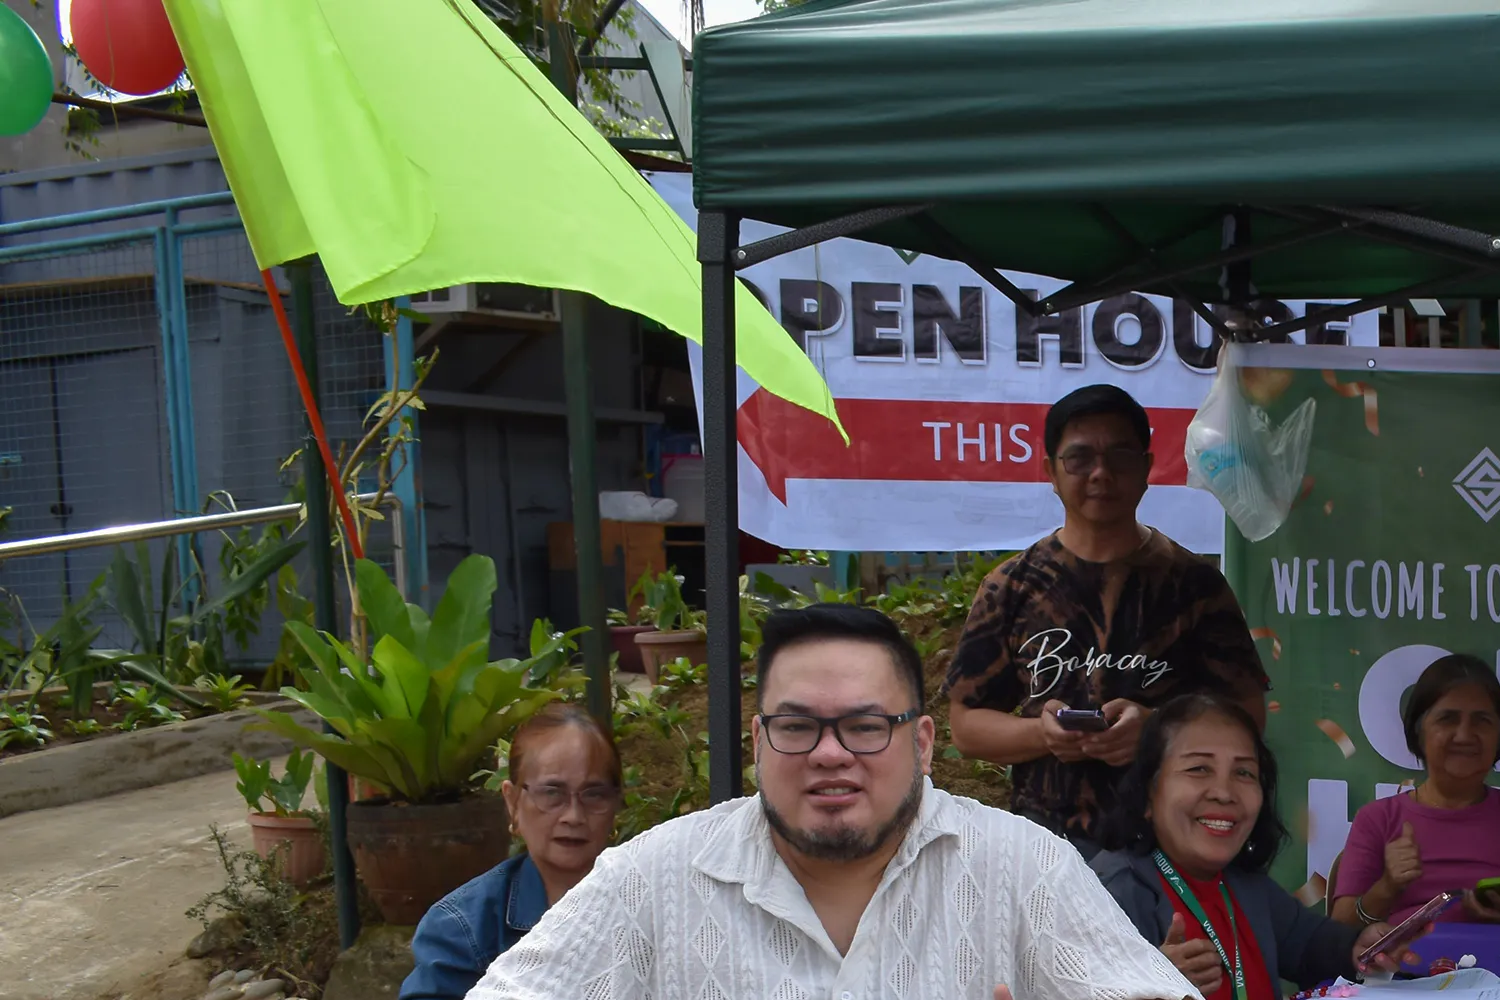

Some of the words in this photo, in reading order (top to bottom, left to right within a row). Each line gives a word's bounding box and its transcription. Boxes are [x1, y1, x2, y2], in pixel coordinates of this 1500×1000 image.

[735, 275, 987, 366] PEN
[922, 421, 1033, 464] THIS
[1271, 556, 1447, 620] WELCOME
[1203, 920, 1216, 938] VVS
